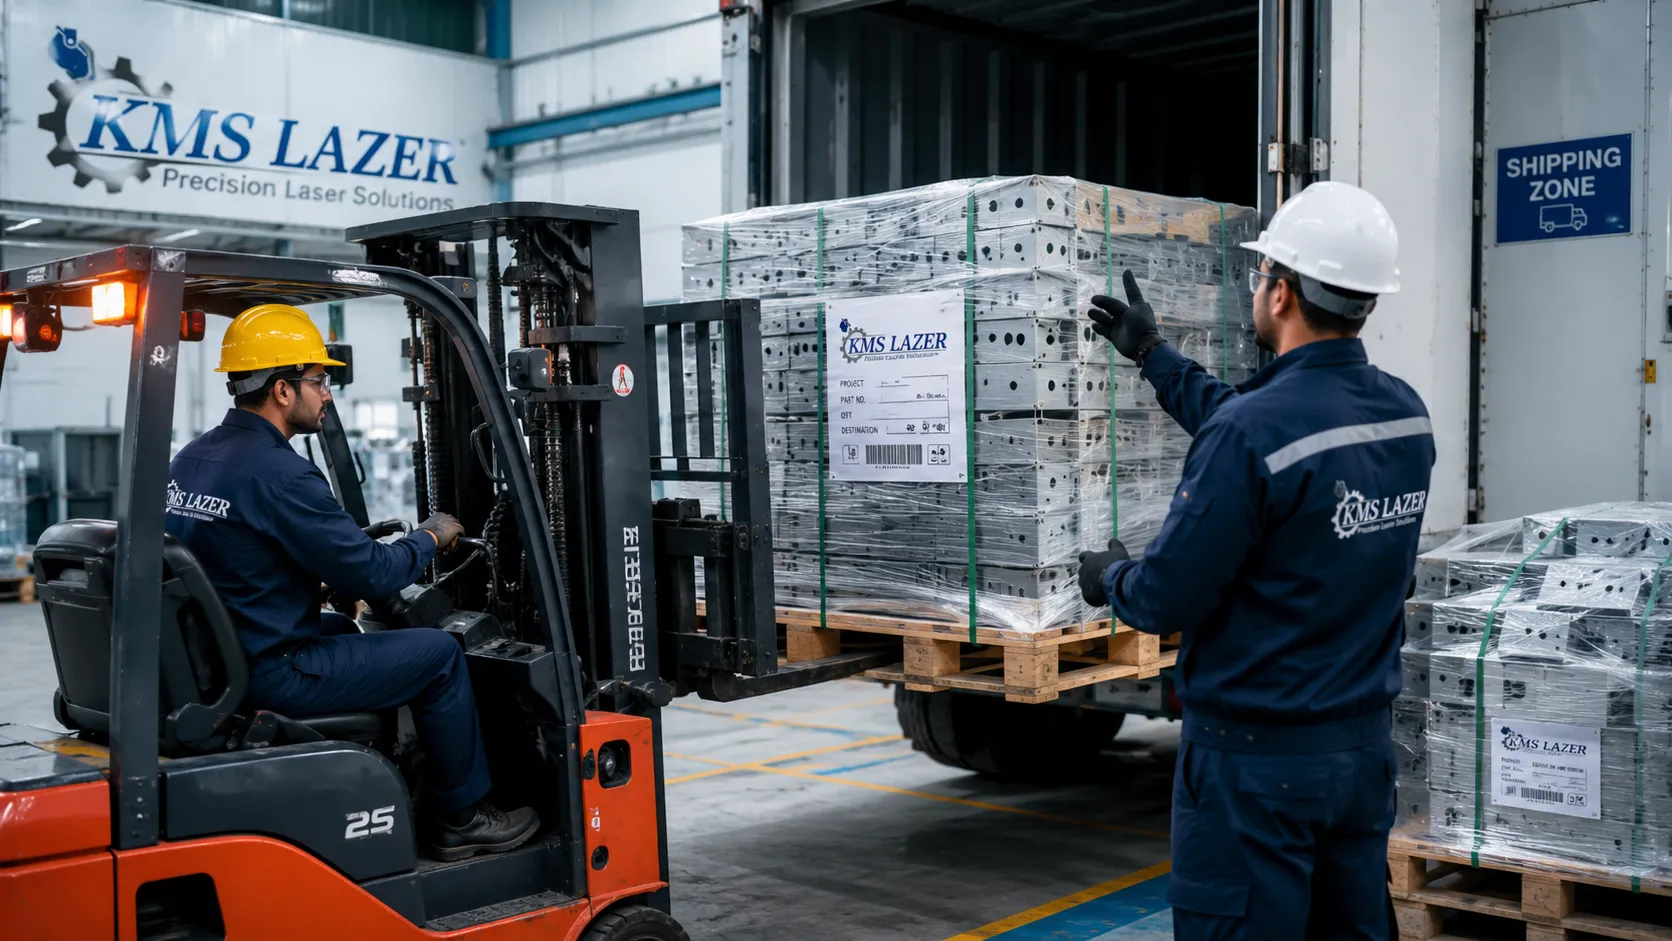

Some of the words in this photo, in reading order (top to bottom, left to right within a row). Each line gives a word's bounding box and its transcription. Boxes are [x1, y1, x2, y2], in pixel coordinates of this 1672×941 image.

[79, 94, 256, 163] KMS
[269, 118, 459, 186] LAZER
[1506, 146, 1622, 178] SHIPPING
[161, 167, 277, 198] Precision
[284, 180, 346, 204] Laser
[352, 186, 455, 212] Solutions
[1529, 175, 1596, 201] ZONE
[849, 336, 886, 354] KMS
[890, 332, 947, 352] LAZER
[185, 493, 231, 517] LAZER
[1342, 500, 1380, 525] KMS
[1382, 491, 1426, 517] LAZER
[1509, 738, 1539, 749] KMS
[1543, 741, 1587, 755] LAZER
[345, 805, 395, 839] 25
